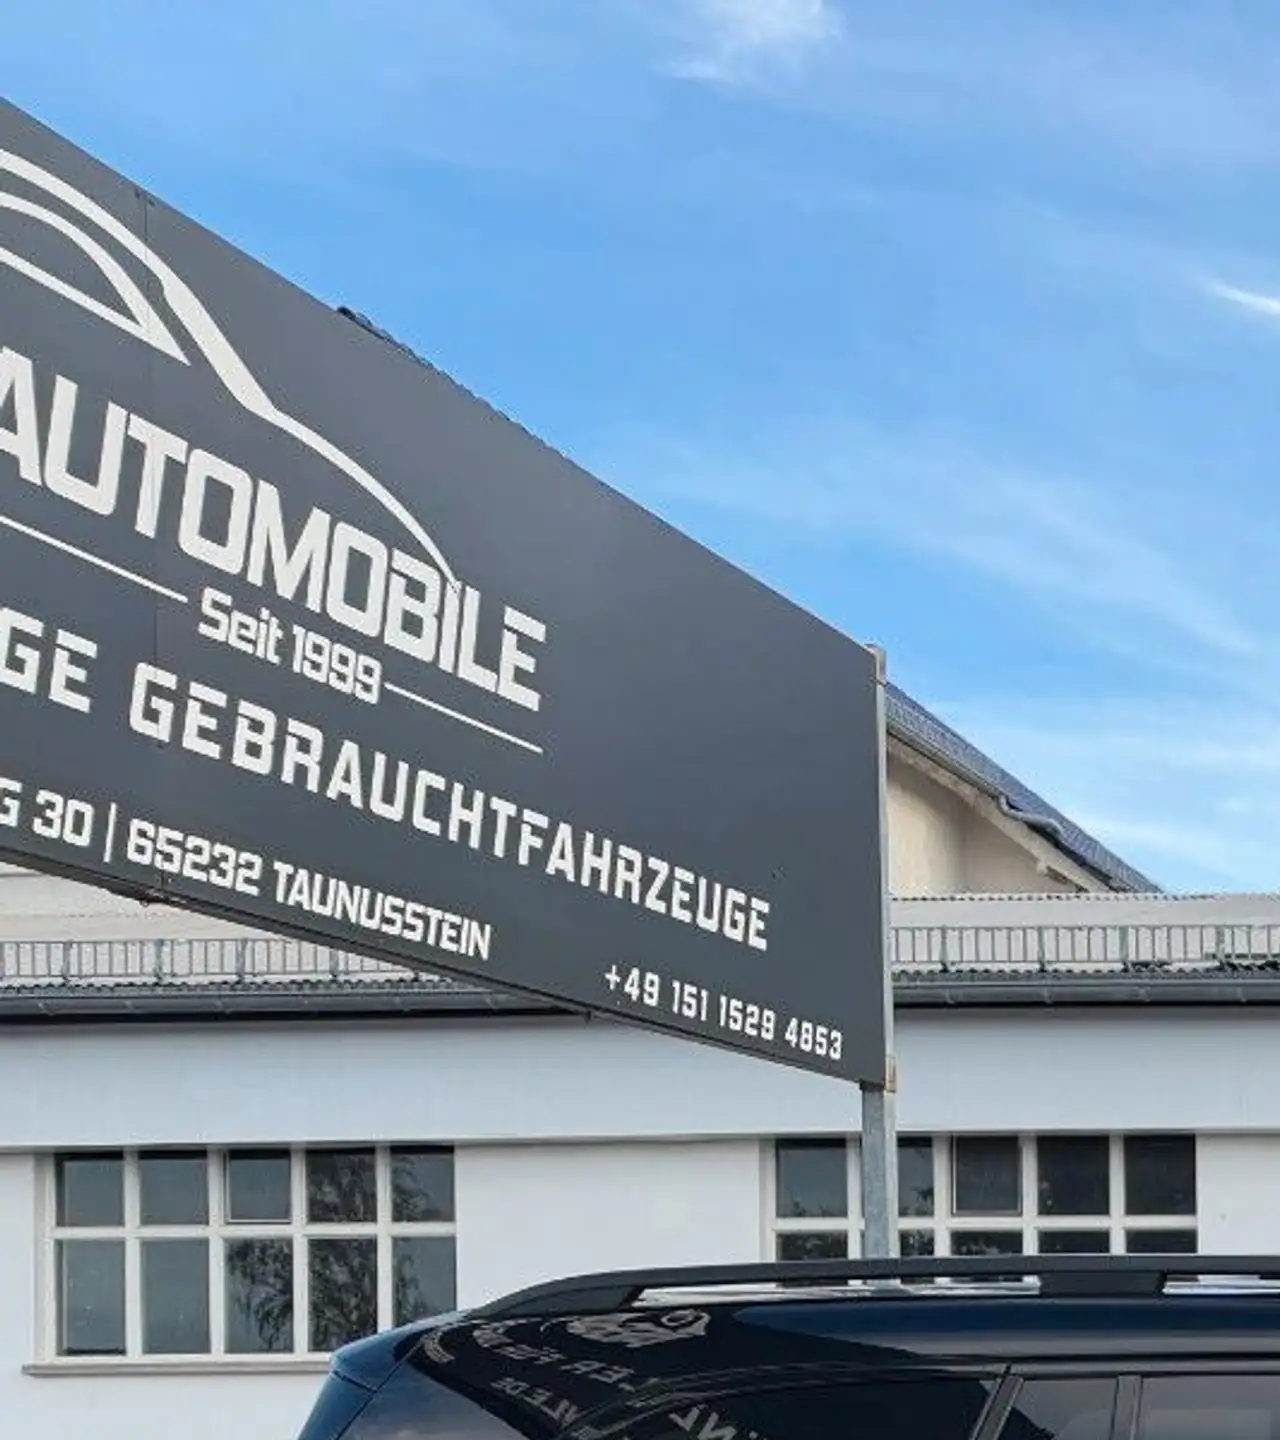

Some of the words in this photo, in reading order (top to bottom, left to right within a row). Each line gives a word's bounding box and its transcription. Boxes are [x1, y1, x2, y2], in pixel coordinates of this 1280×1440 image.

[198, 586, 284, 666] Seit
[292, 624, 382, 704] 1999
[0, 606, 98, 714] GE
[129, 662, 770, 951] GEBRAUCHTFAHRZEUGE
[33, 789, 95, 847] 30
[127, 818, 263, 896] 65232
[273, 860, 492, 961] TAUNUSSTEIN
[605, 964, 660, 1007] +49
[672, 980, 709, 1022] 151
[719, 995, 776, 1041] 1529
[785, 1017, 843, 1060] 4853
